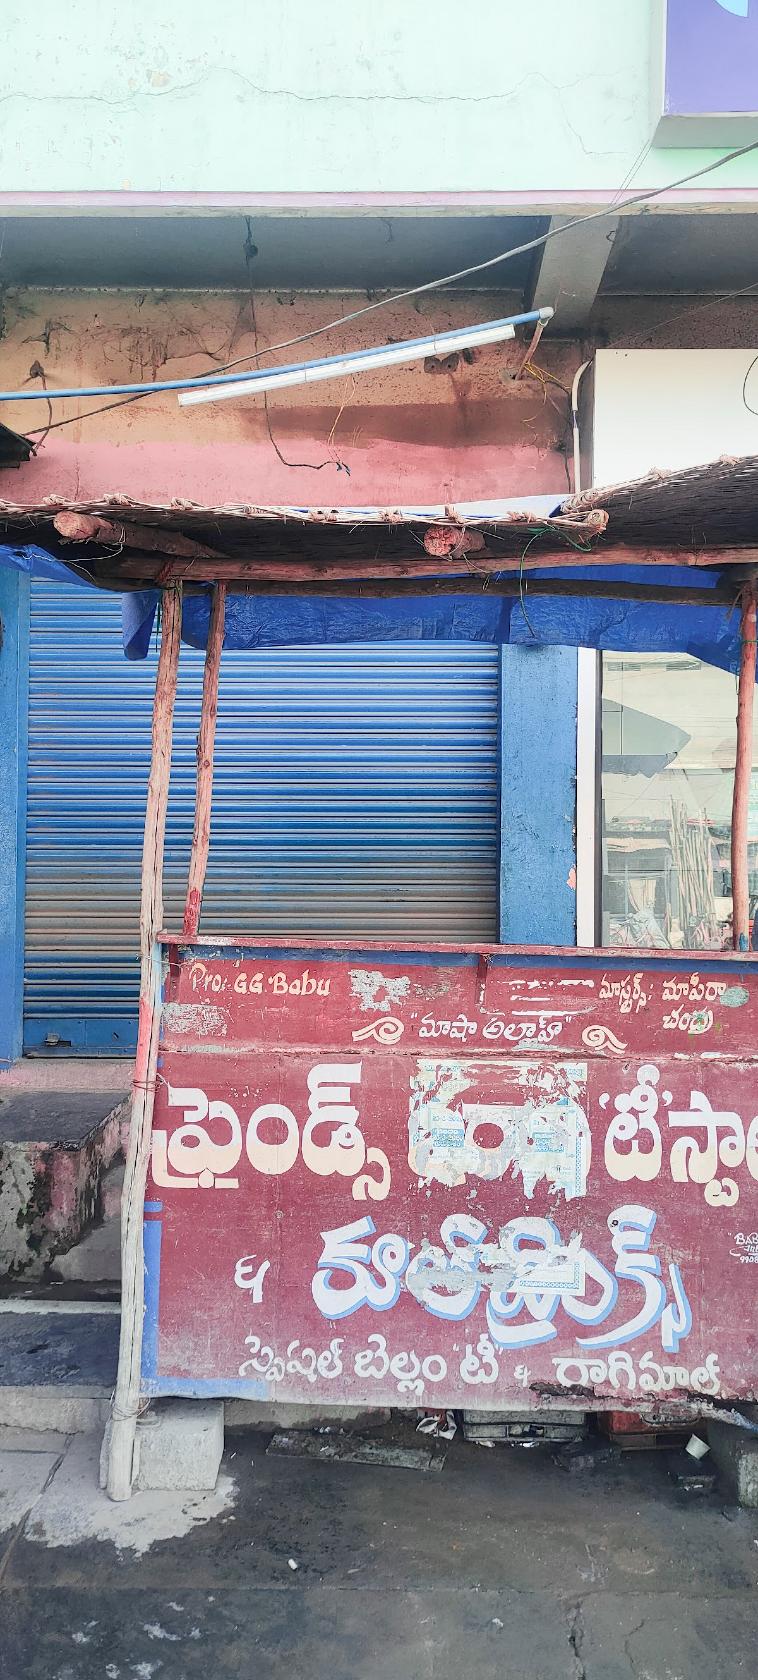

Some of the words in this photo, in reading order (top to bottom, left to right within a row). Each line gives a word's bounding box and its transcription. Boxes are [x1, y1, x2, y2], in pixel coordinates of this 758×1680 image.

[268, 969, 331, 997] Babu
[234, 1254, 270, 1303] &
[354, 1334, 448, 1396] బెల్లం
